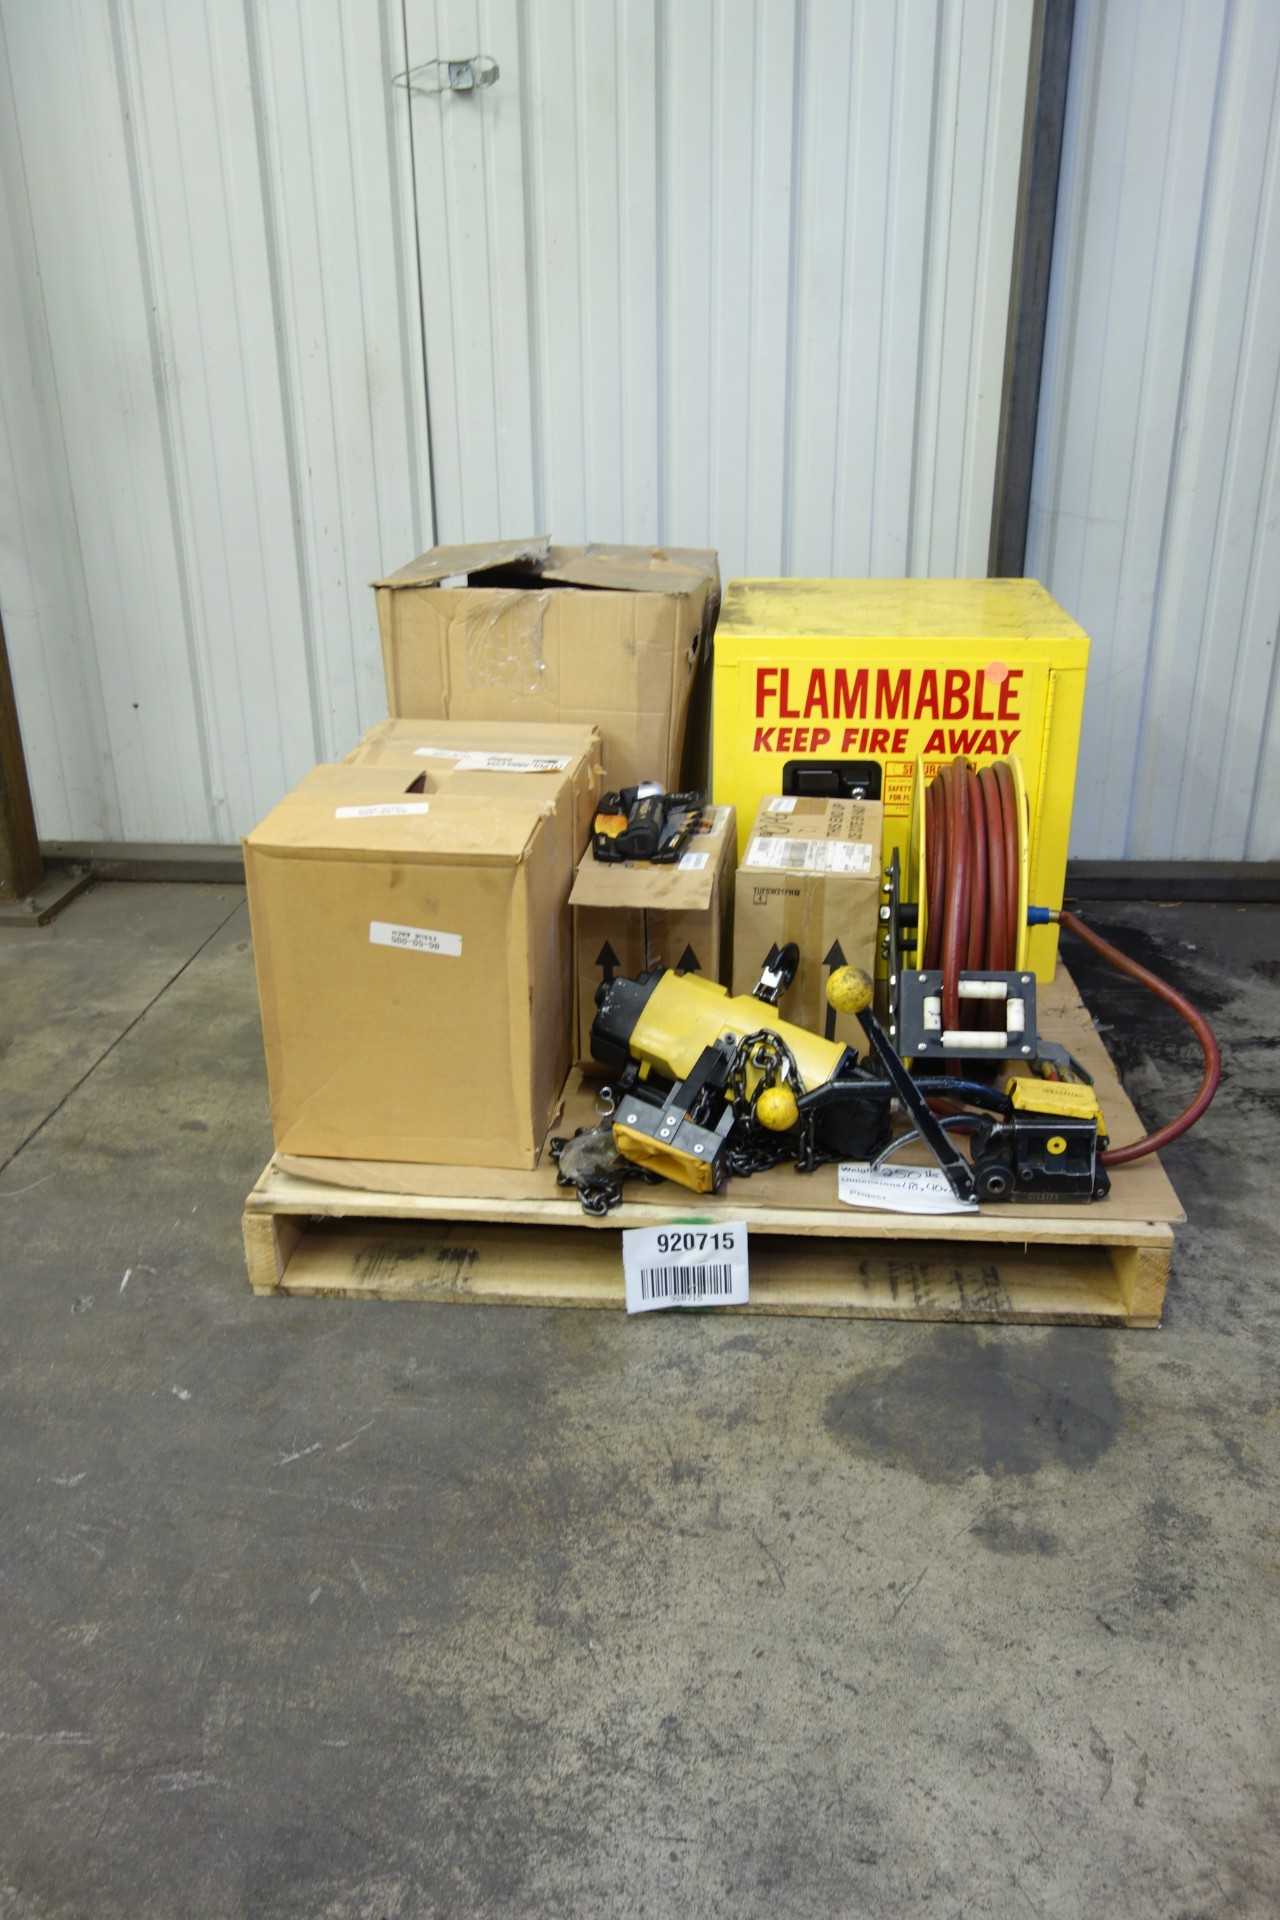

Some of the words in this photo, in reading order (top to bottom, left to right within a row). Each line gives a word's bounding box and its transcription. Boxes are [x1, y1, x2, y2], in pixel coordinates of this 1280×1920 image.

[755, 667, 1024, 721] FLAMMABLE
[753, 727, 831, 753] KEEP
[841, 728, 909, 754] FIRE
[923, 729, 1022, 755] AWAY
[656, 1231, 735, 1253] 920715
